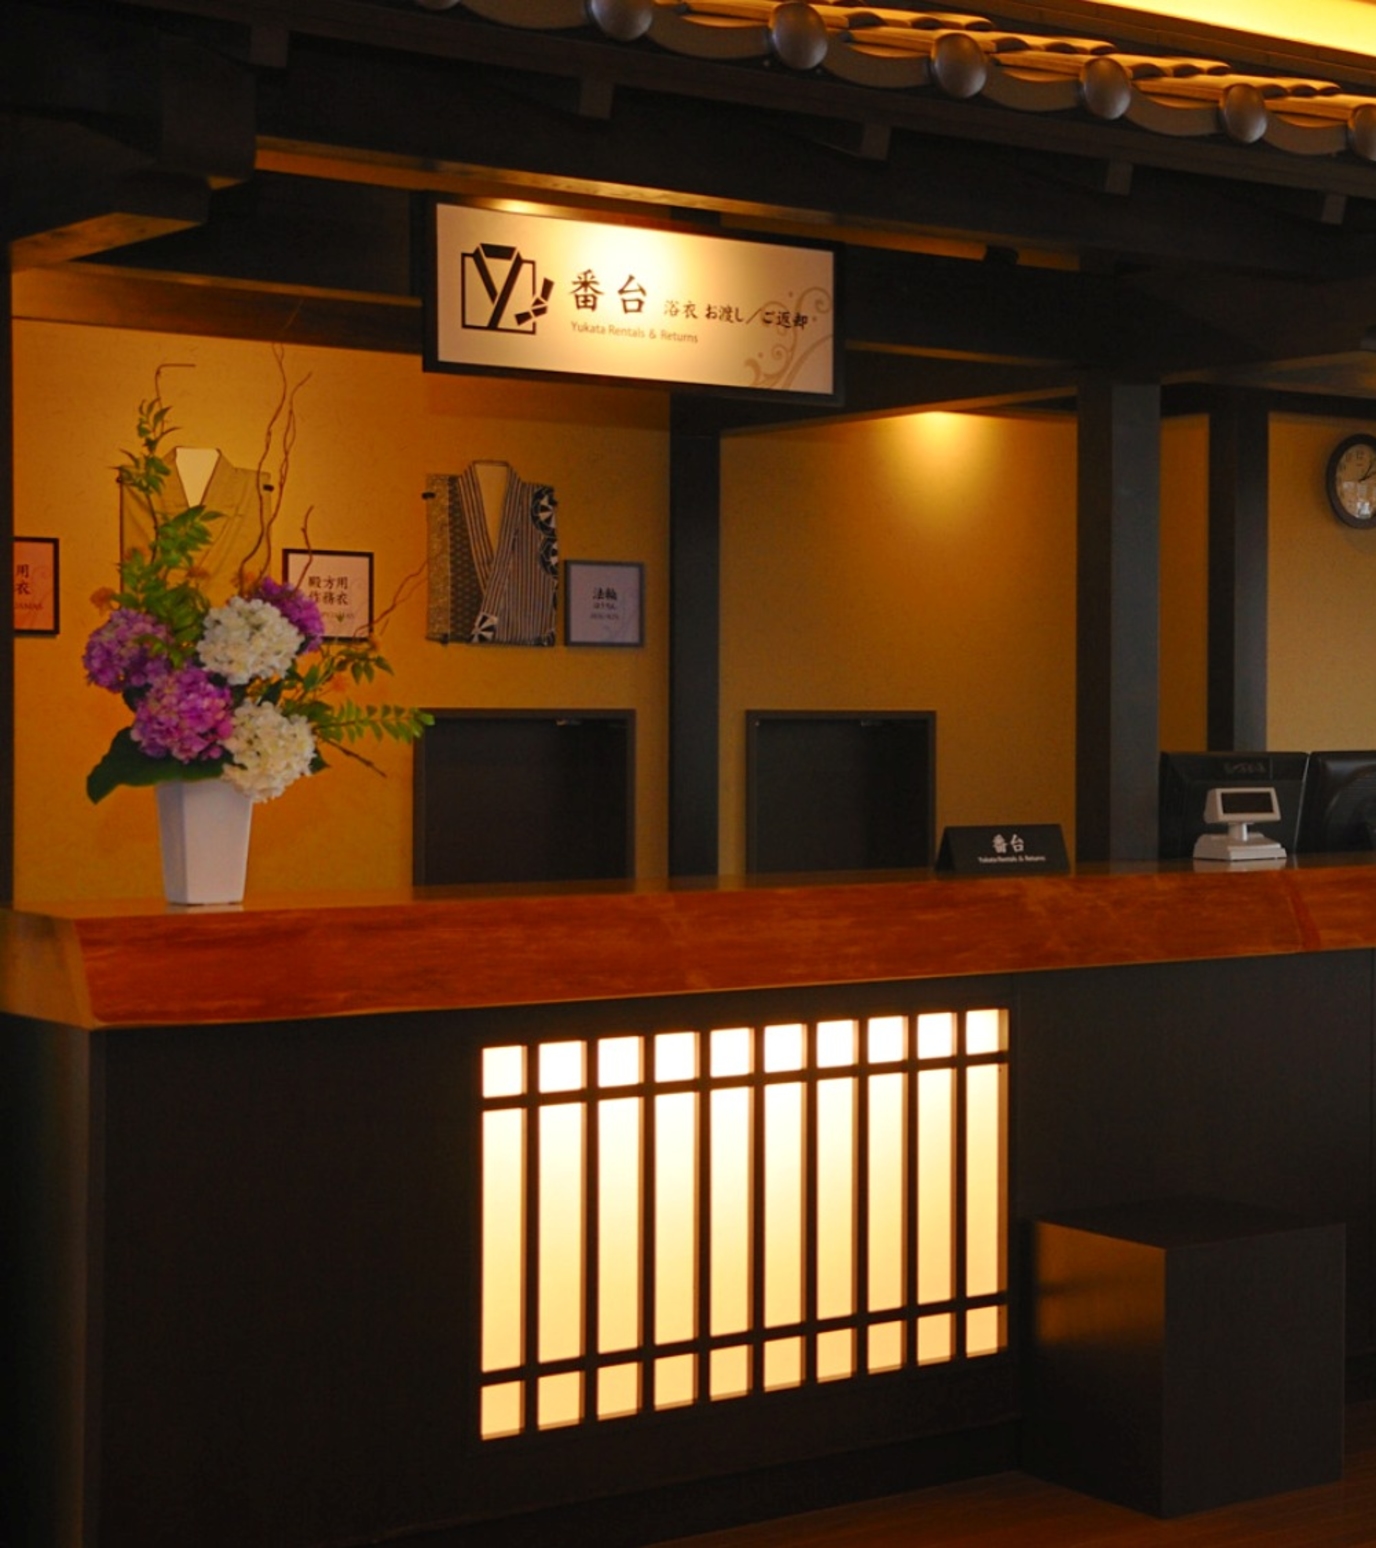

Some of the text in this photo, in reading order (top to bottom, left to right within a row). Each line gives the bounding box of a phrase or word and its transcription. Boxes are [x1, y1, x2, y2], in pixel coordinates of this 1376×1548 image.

[569, 268, 647, 314] 番台
[663, 299, 699, 320] 浴衣
[570, 321, 699, 344] Yukata Rentals & Returns
[992, 833, 1025, 854] 番台
